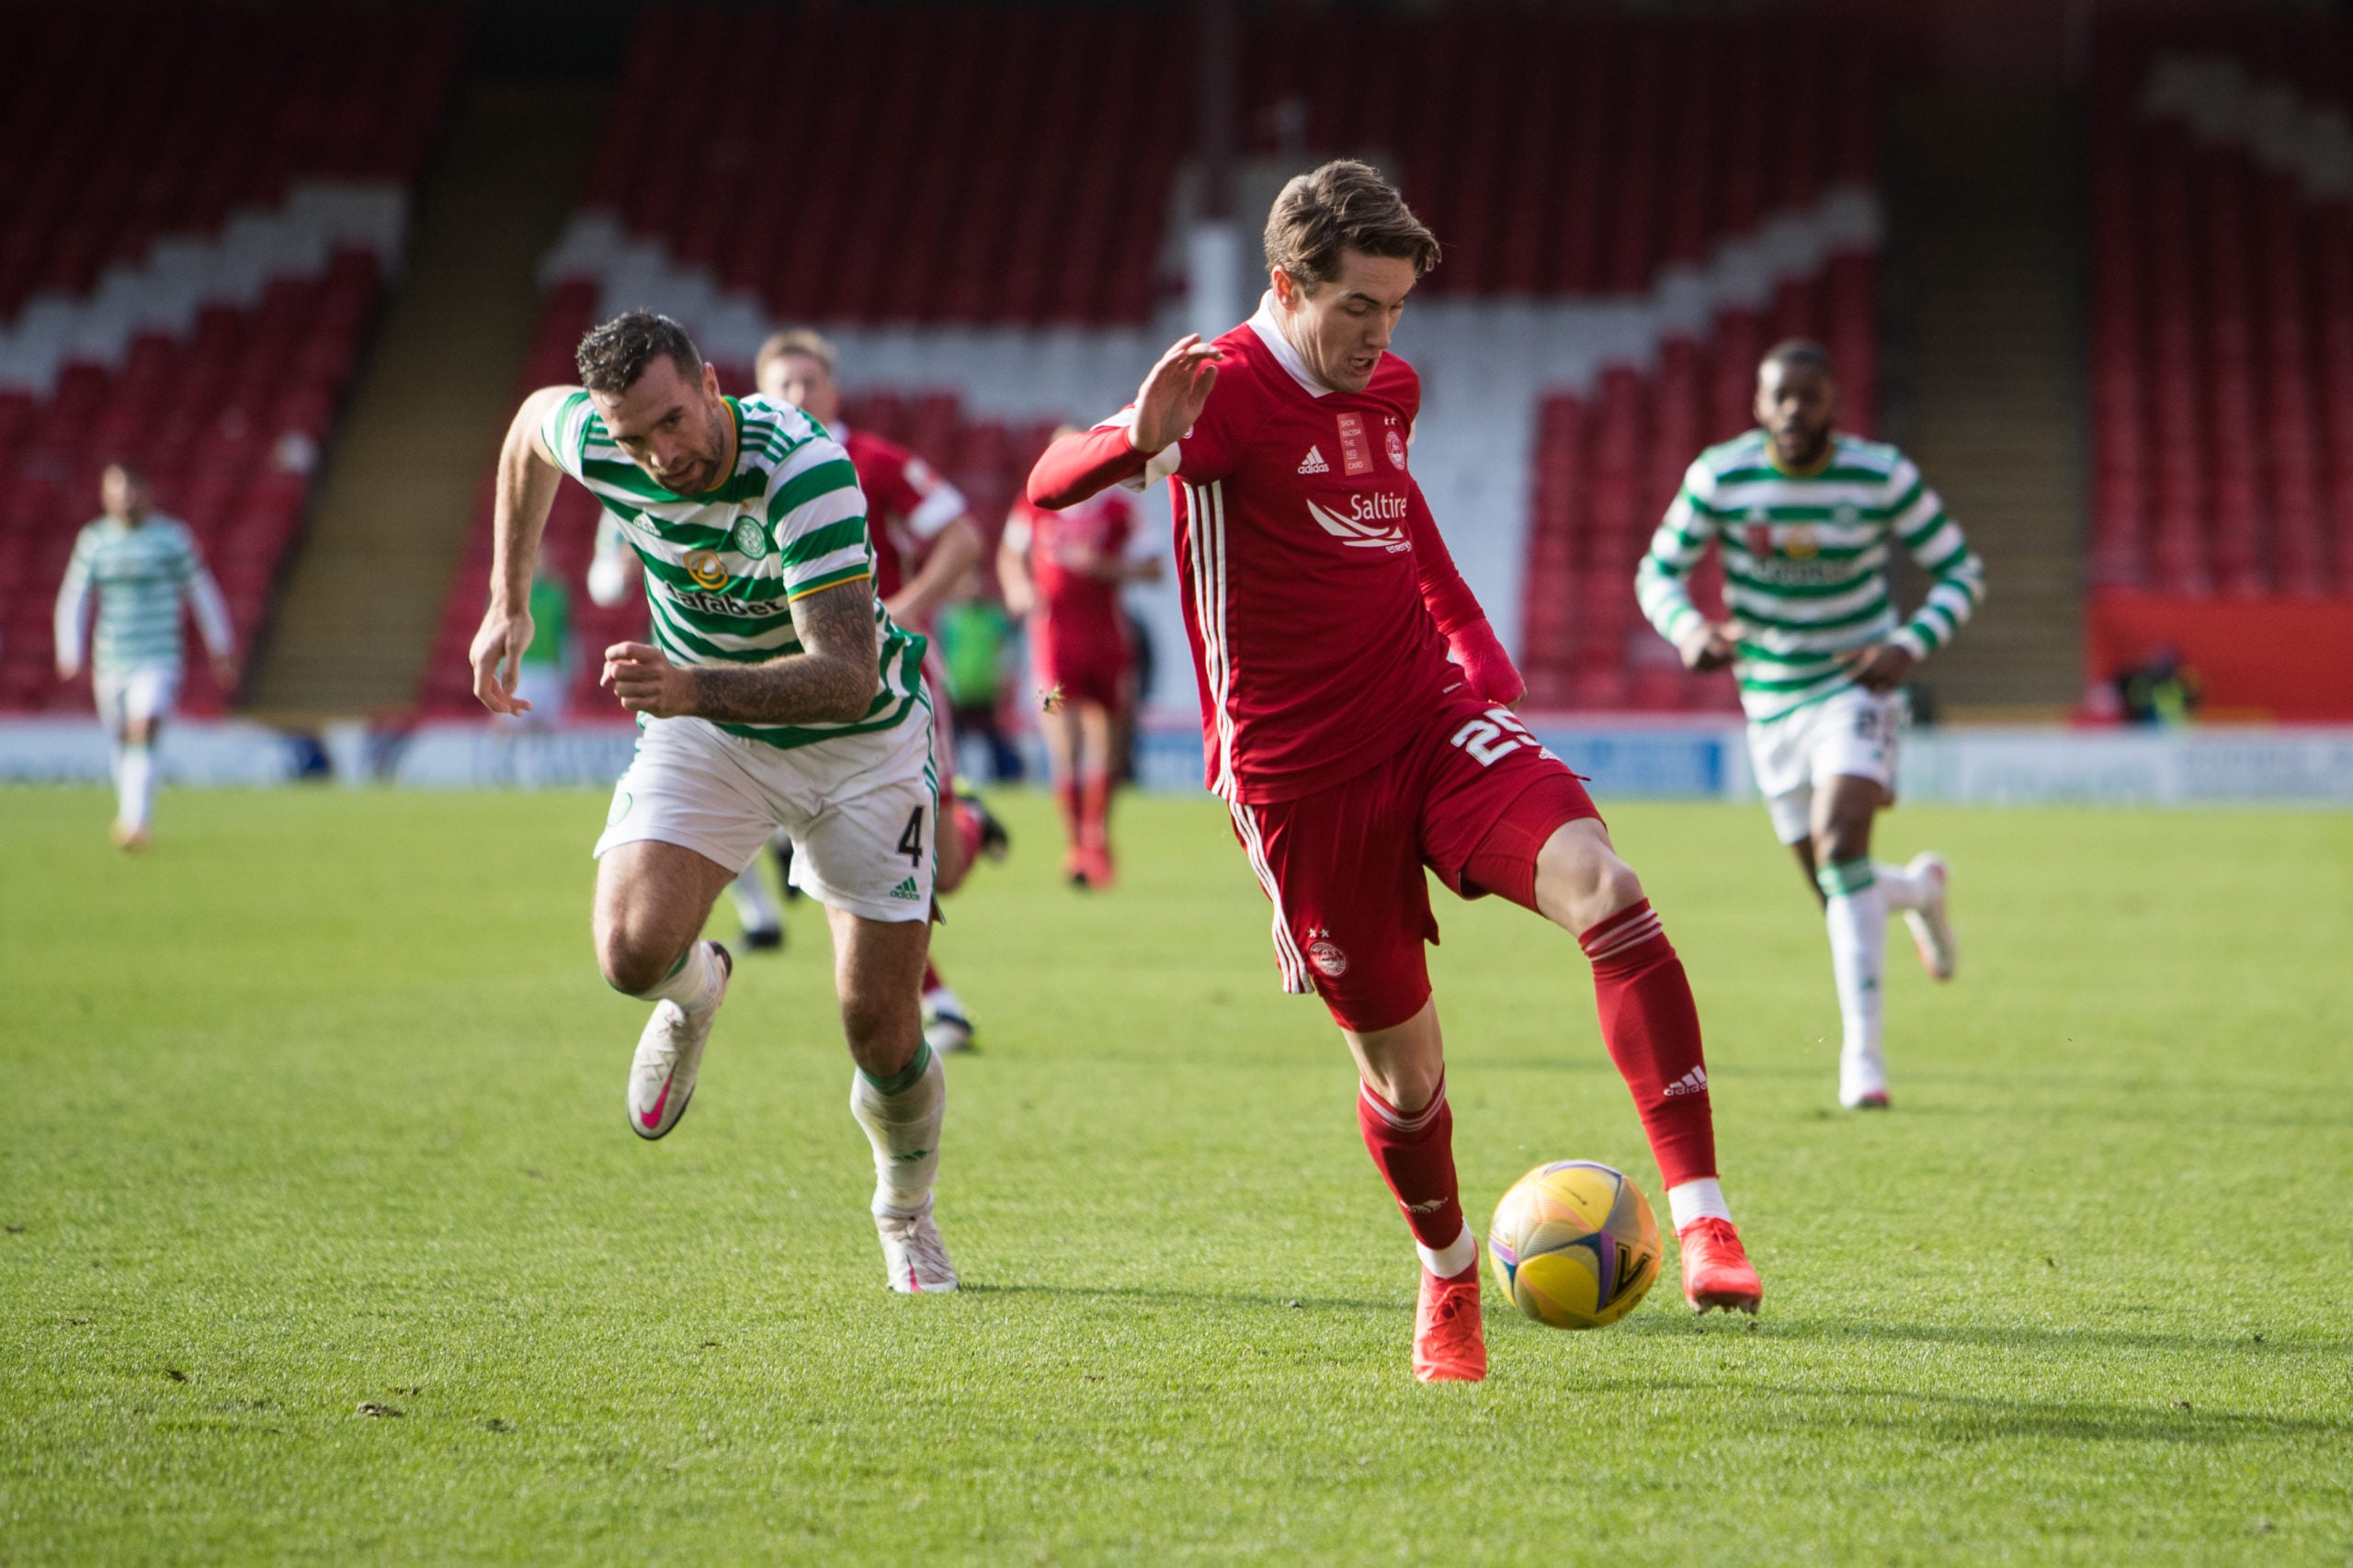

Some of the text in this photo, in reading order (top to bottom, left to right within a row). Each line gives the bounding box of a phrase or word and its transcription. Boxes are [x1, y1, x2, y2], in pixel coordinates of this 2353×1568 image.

[1342, 428, 1361, 437] RACISM
[1297, 464, 1329, 474] adidas
[1347, 461, 1364, 470] CARD
[1351, 493, 1406, 520] Saltire
[897, 805, 924, 868] 4
[890, 890, 920, 901] adidas
[1663, 1082, 1707, 1096] adida
